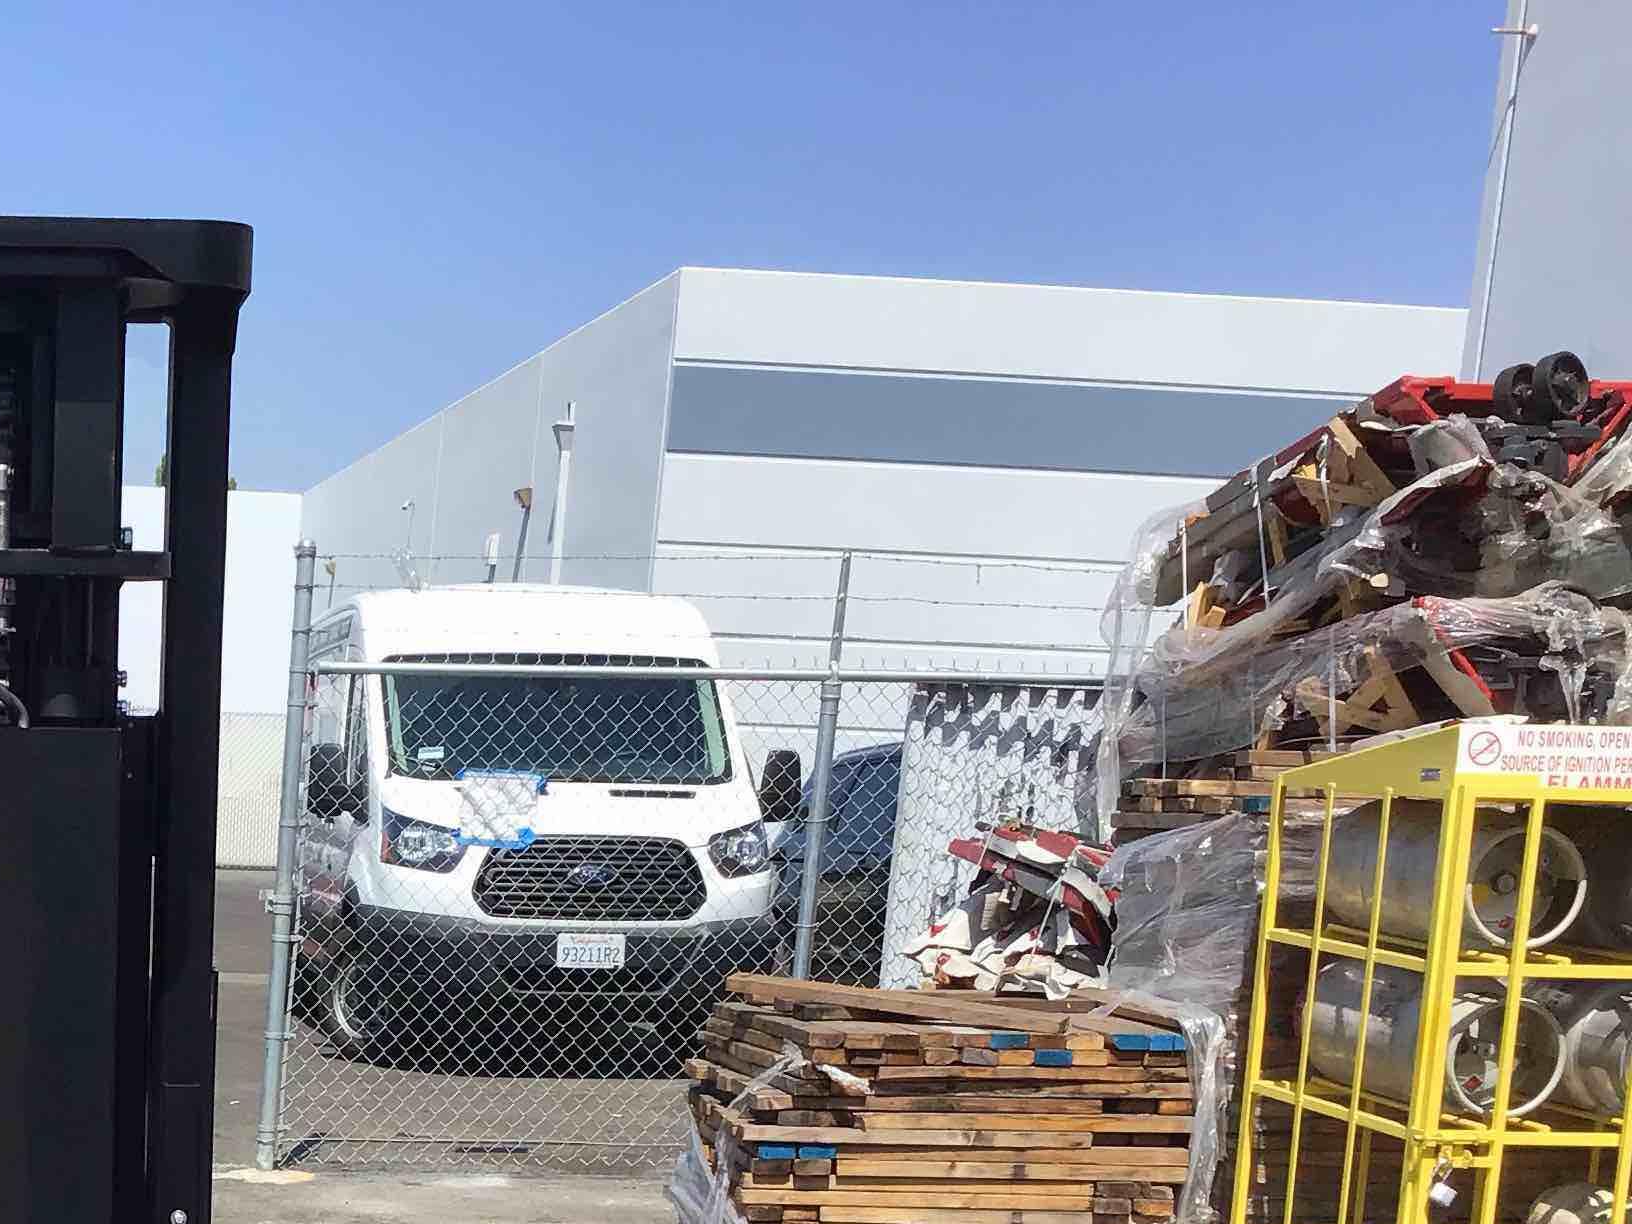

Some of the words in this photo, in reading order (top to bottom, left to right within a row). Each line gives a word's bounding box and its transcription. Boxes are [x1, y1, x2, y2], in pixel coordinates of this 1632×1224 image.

[1518, 730, 1535, 747] NO
[1501, 754, 1546, 772] SOURCE
[1547, 755, 1563, 772] OF
[1565, 756, 1611, 773] IGNITION
